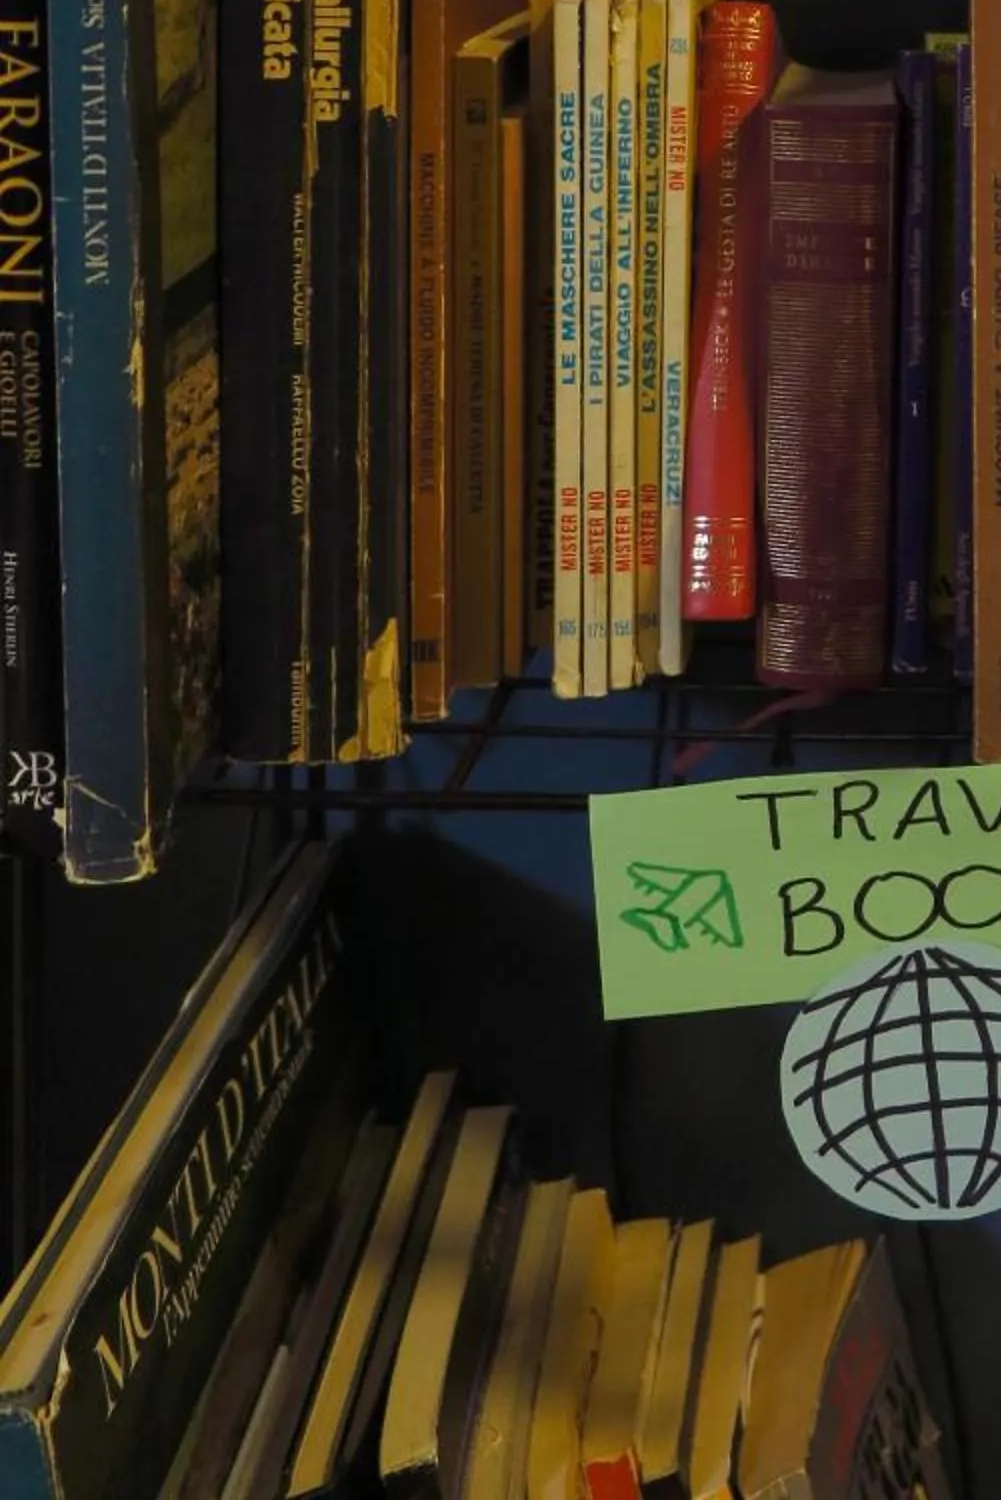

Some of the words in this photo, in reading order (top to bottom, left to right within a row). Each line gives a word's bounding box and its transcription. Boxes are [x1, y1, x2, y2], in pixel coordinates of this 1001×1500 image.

[81, 41, 108, 176] D'ITALIA
[560, 92, 575, 182] SACRE
[669, 105, 687, 163] MISTER
[0, 17, 44, 306] FARAONI
[588, 93, 604, 194] GUINEA
[643, 63, 661, 234] NELL'OMBRA
[720, 157, 739, 180] RE
[418, 152, 436, 250] MACCHINE
[617, 98, 632, 271] ALL'INFERNO
[669, 170, 686, 191] NO
[719, 187, 738, 208] DI
[83, 186, 109, 286] MONTI
[419, 258, 434, 271] A
[588, 205, 604, 293] DELLA
[717, 213, 737, 272] GESTA
[560, 194, 576, 341] MASCHERE
[715, 279, 733, 298] LE
[0, 330, 16, 342] E
[419, 277, 436, 342] FLUIDO
[616, 283, 631, 388] VIAGGIO
[641, 241, 658, 414] L'ASSASSINO
[561, 353, 576, 385] LE
[589, 304, 604, 387] PIRATI
[21, 329, 43, 469] CAPOLAVORI
[665, 361, 683, 508] VERACRUZ!
[561, 487, 578, 507] NO
[588, 491, 604, 511] NO
[615, 489, 631, 509] NO
[640, 484, 658, 504] NO
[561, 516, 578, 571] MISTER
[588, 518, 605, 576] MISTER
[615, 516, 632, 573] MISTER
[641, 510, 658, 566] MISTER
[94, 1123, 219, 1421] MONTI
